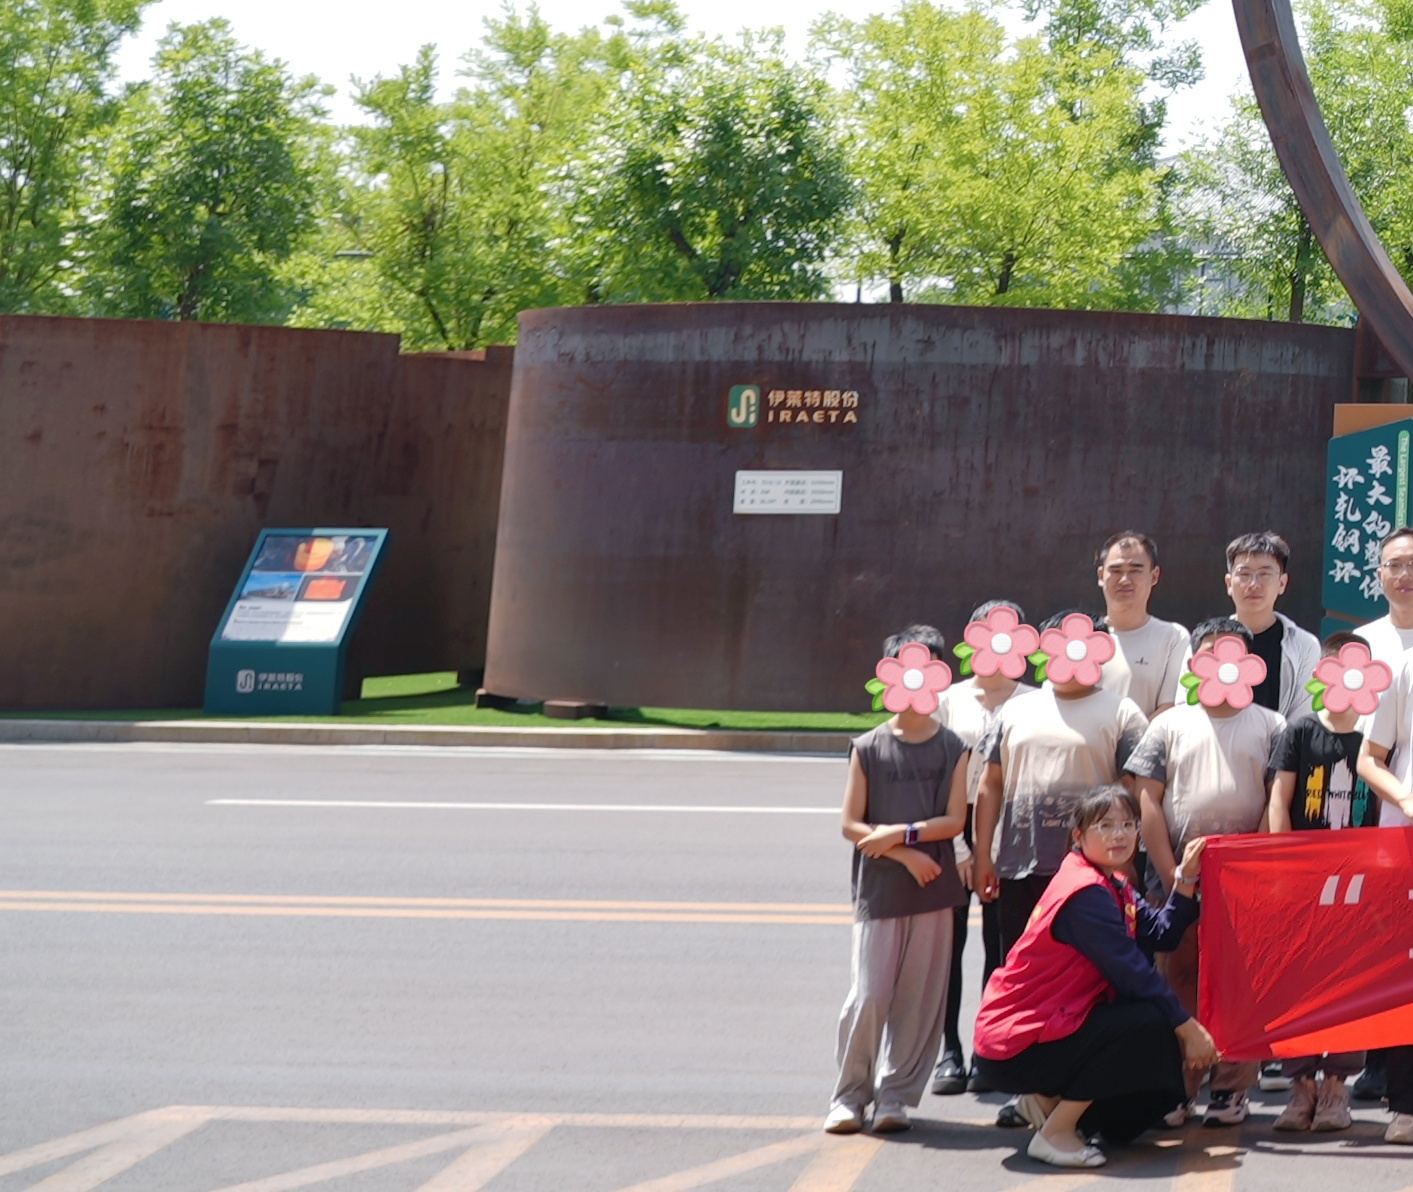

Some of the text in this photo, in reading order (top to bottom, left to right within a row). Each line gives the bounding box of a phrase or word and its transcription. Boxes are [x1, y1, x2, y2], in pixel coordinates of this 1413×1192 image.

[767, 389, 860, 408] 伊莱特股份
[767, 410, 858, 424] IRAETA
